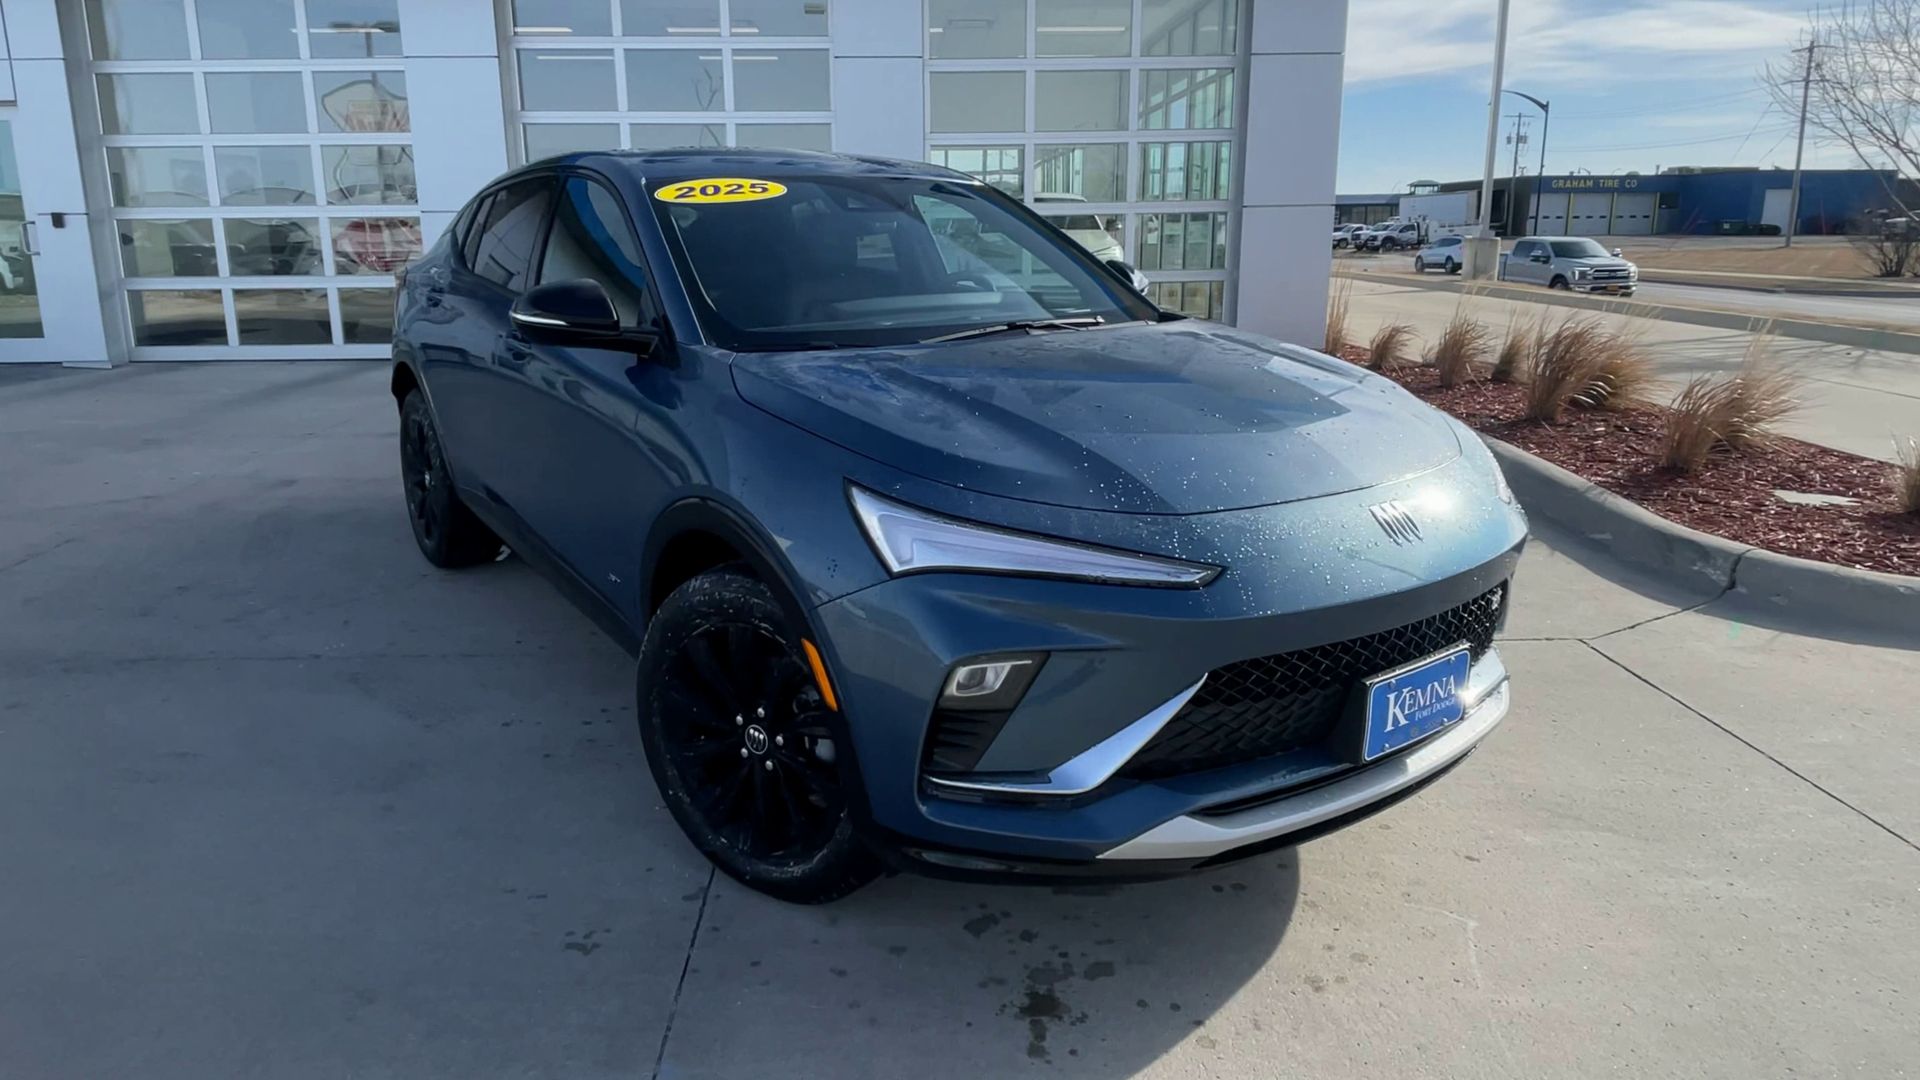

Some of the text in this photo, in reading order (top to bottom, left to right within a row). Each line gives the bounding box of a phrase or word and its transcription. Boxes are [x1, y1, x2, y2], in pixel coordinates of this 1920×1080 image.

[673, 183, 769, 199] 2025
[1551, 179, 1638, 189] GRAHAM TIRE CO
[1384, 675, 1456, 733] KEMNA
